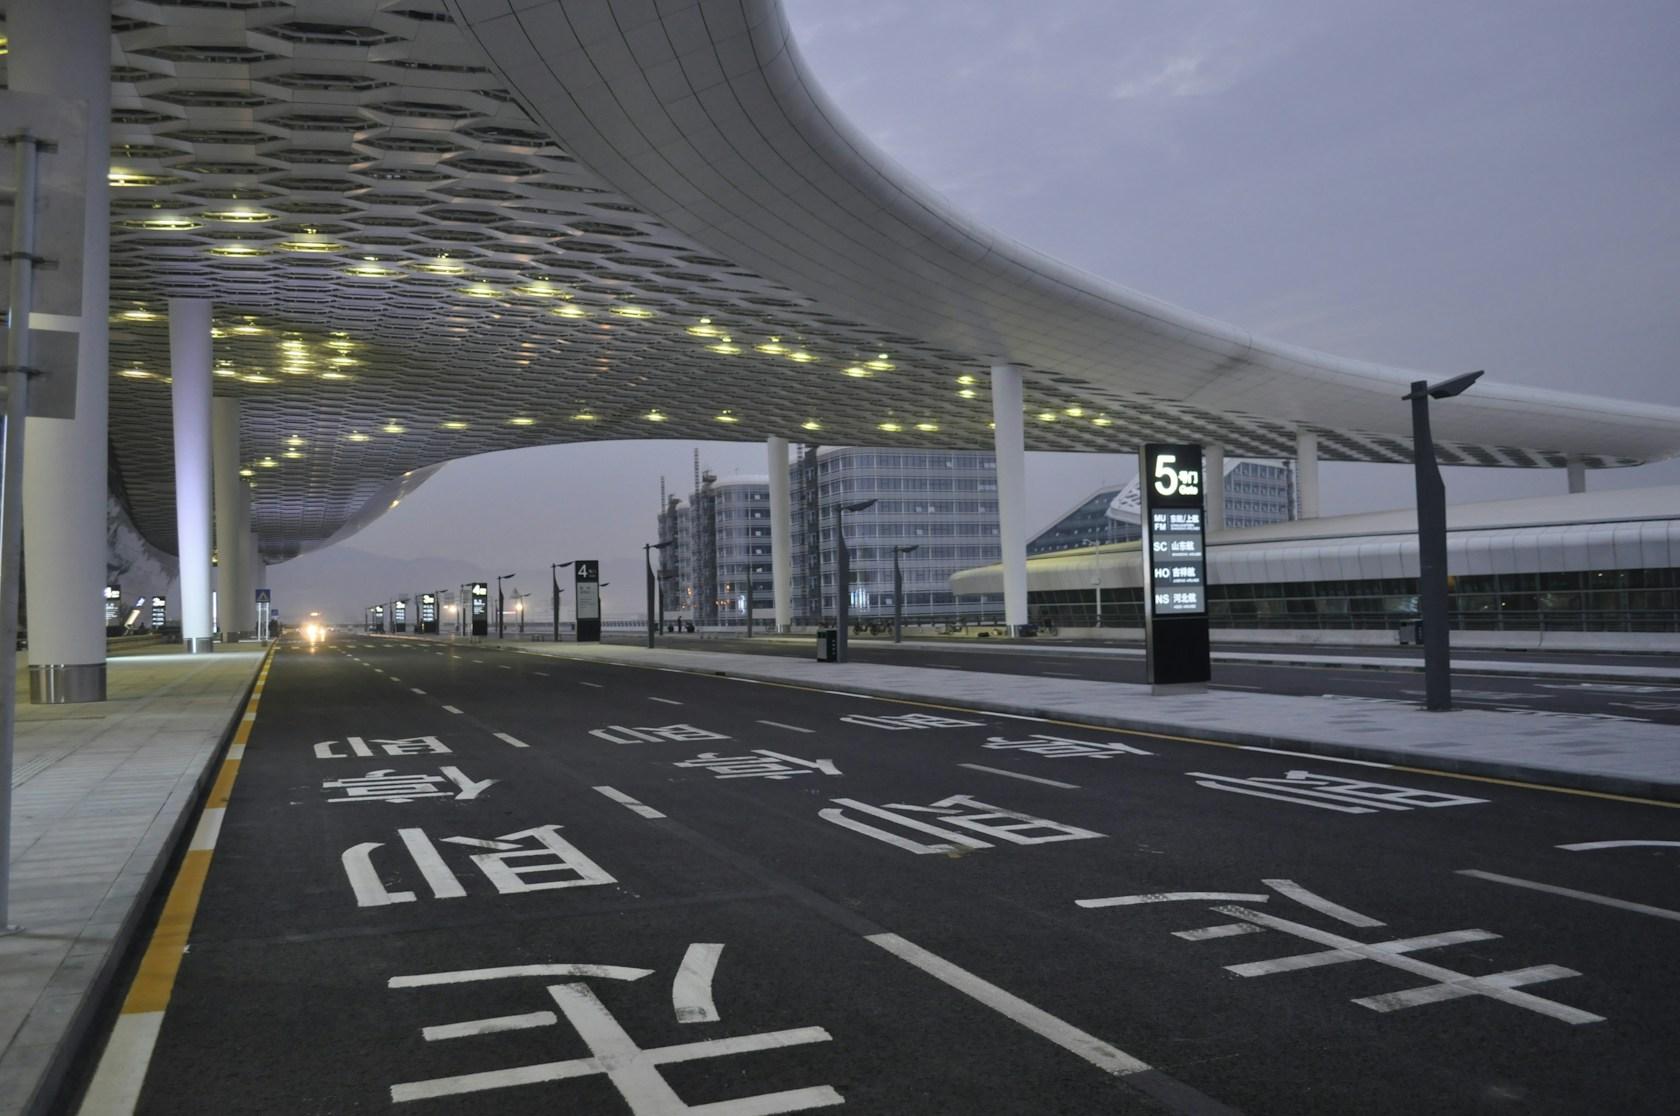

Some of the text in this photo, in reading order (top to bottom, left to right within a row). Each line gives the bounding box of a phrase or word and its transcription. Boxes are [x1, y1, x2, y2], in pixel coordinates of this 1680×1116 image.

[1154, 454, 1178, 496] 5
[1153, 514, 1167, 522] MU
[1154, 523, 1167, 531] FM
[1153, 541, 1168, 552] SC
[578, 564, 588, 578] 4
[1154, 568, 1170, 578] HO
[1155, 594, 1170, 604] NS
